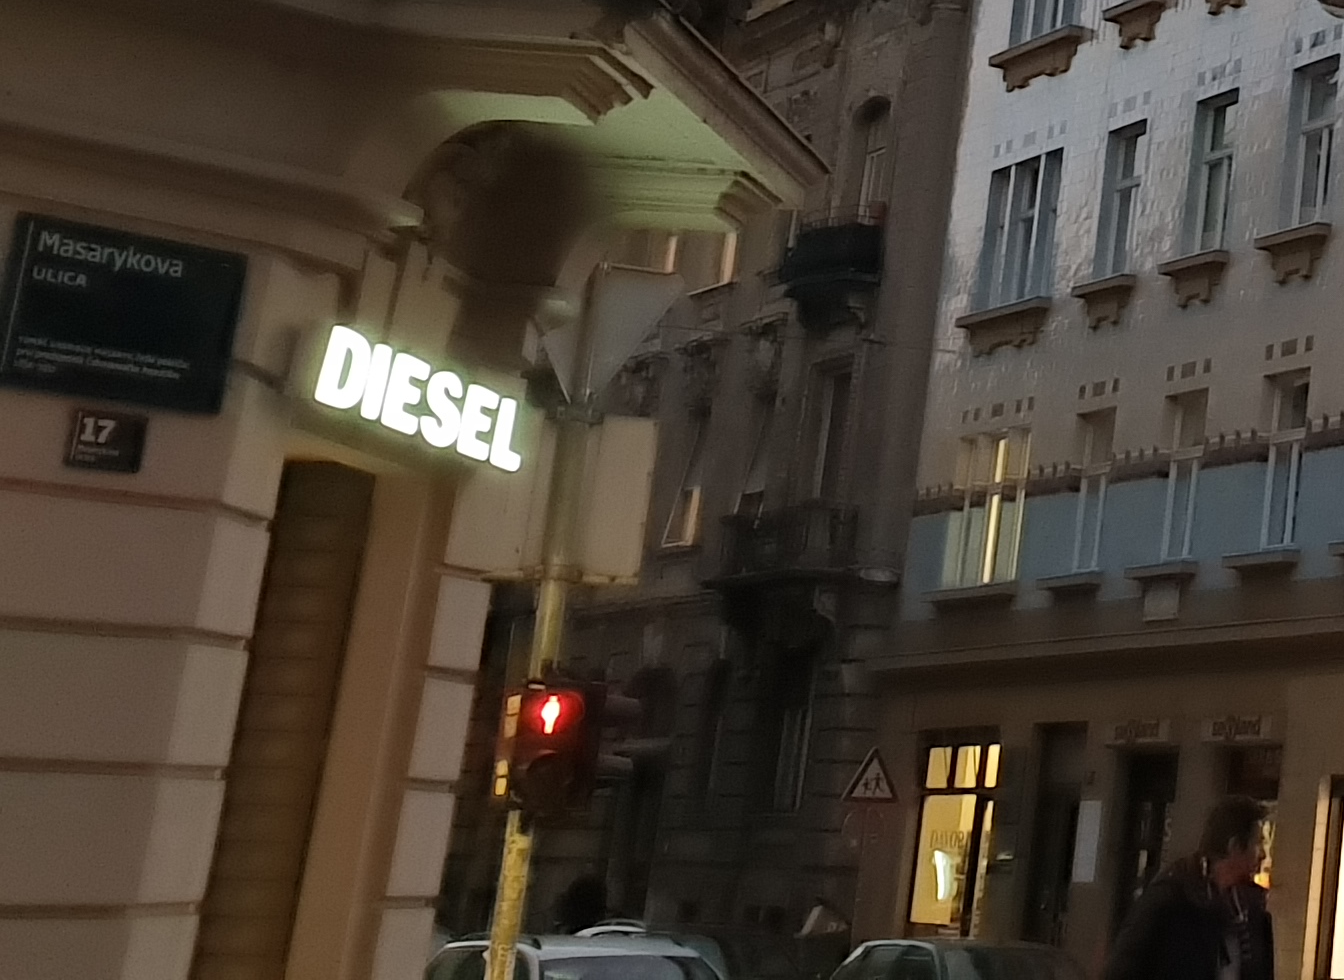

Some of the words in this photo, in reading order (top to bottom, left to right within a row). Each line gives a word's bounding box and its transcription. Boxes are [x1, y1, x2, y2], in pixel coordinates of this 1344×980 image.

[38, 230, 184, 278] Masarykova
[32, 265, 87, 288] ULICA
[314, 324, 522, 473] DIESEL
[80, 416, 116, 445] 17
